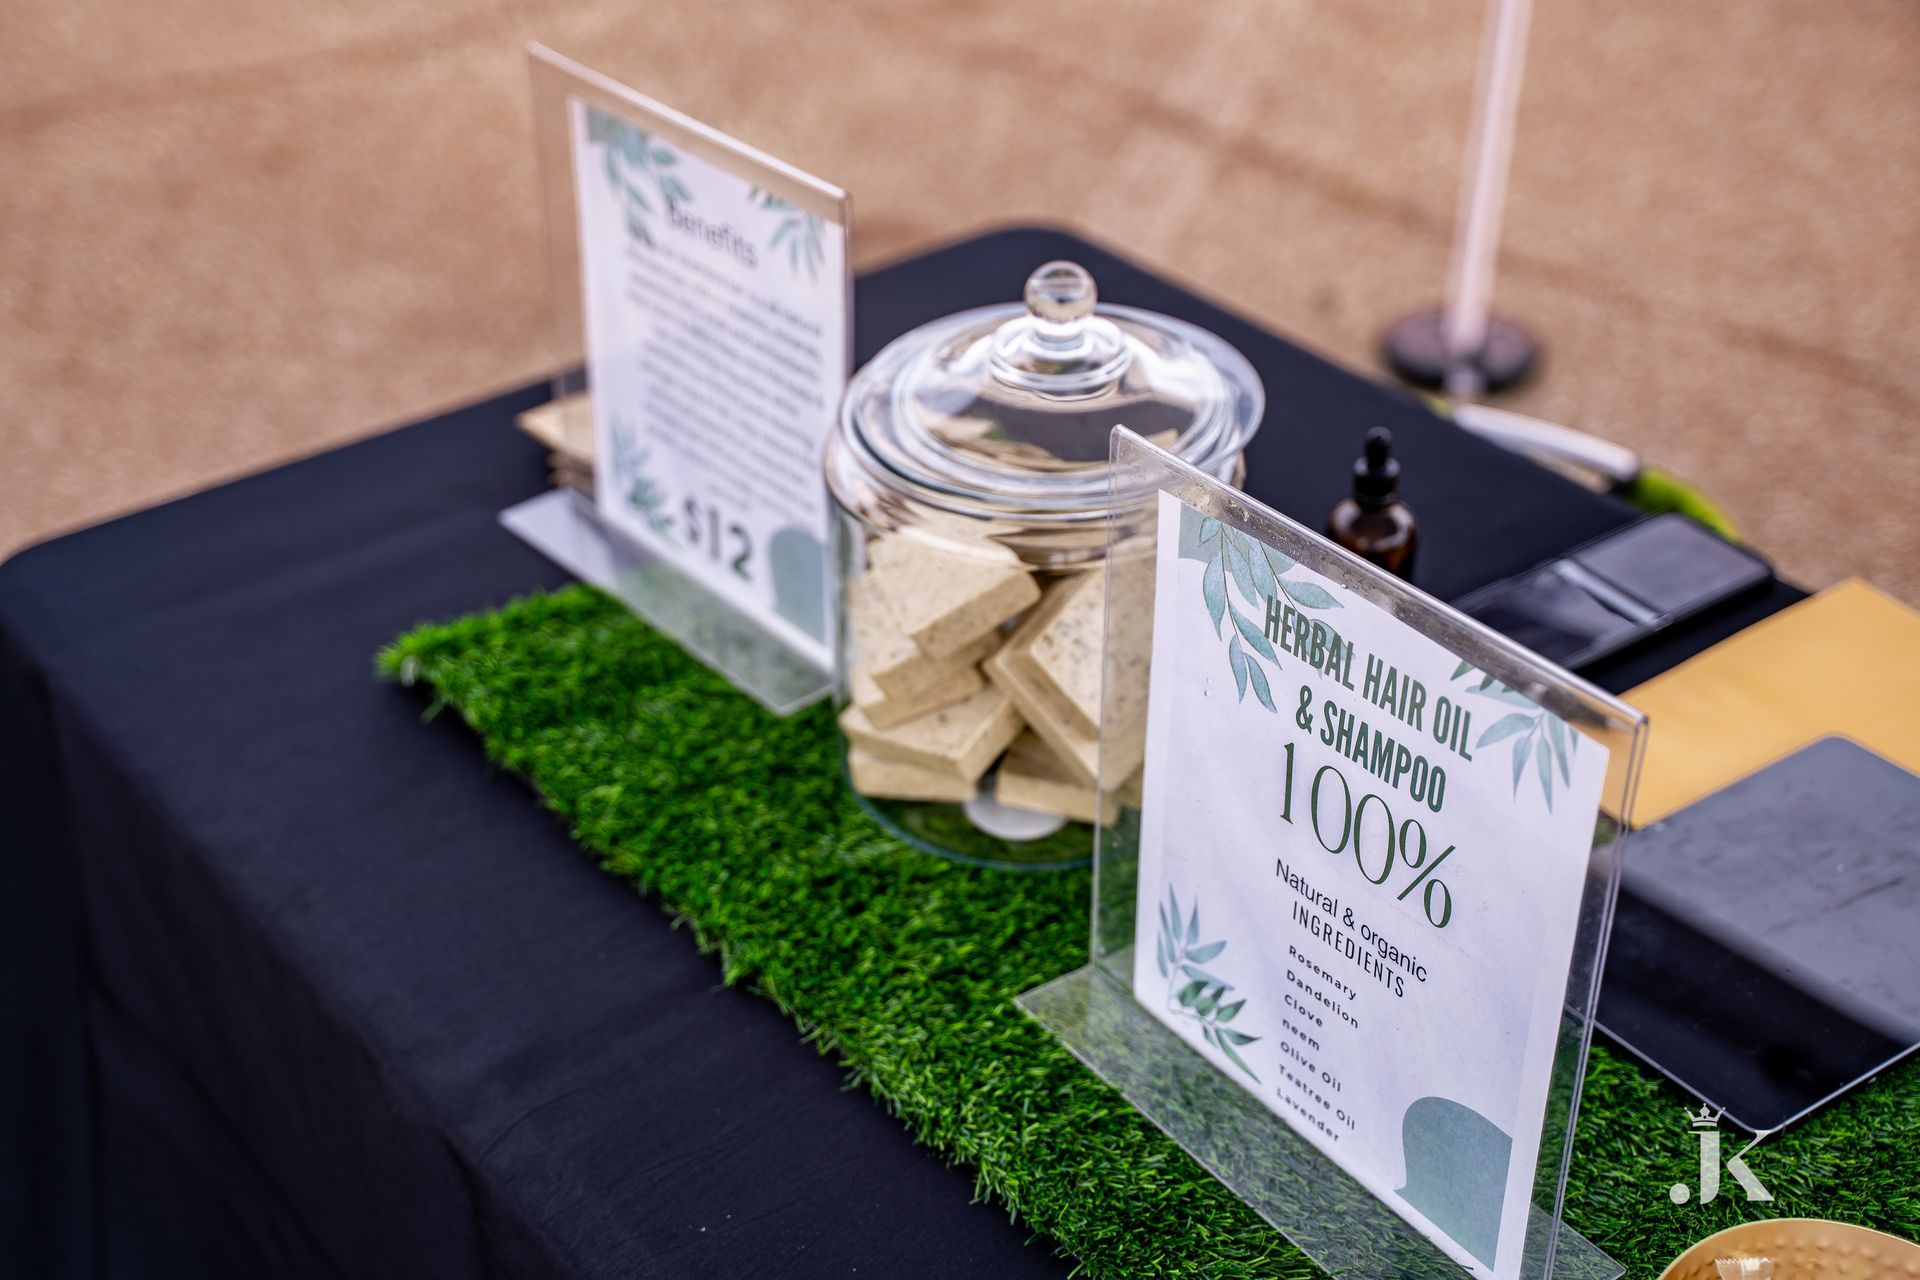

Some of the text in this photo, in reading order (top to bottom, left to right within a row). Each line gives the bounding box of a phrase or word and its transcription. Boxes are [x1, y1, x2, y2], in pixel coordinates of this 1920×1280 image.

[683, 495, 754, 582] $12
[1264, 594, 1473, 762] HERBAL HAIR OIL
[1295, 684, 1447, 813] & SHAMPOO
[1279, 741, 1457, 929] 100%
[1275, 857, 1428, 983] Natural & organic
[1292, 900, 1405, 998] INGREDIENTS
[1286, 969, 1359, 1029] Dandelion
[1288, 944, 1357, 1001] Rosemary
[1282, 1018, 1320, 1051] neem
[1284, 994, 1323, 1028] Clove
[1279, 1063, 1355, 1130] Teatree Oil
[1280, 1041, 1341, 1093] Olive Oil
[1276, 1086, 1340, 1142] Lavender
